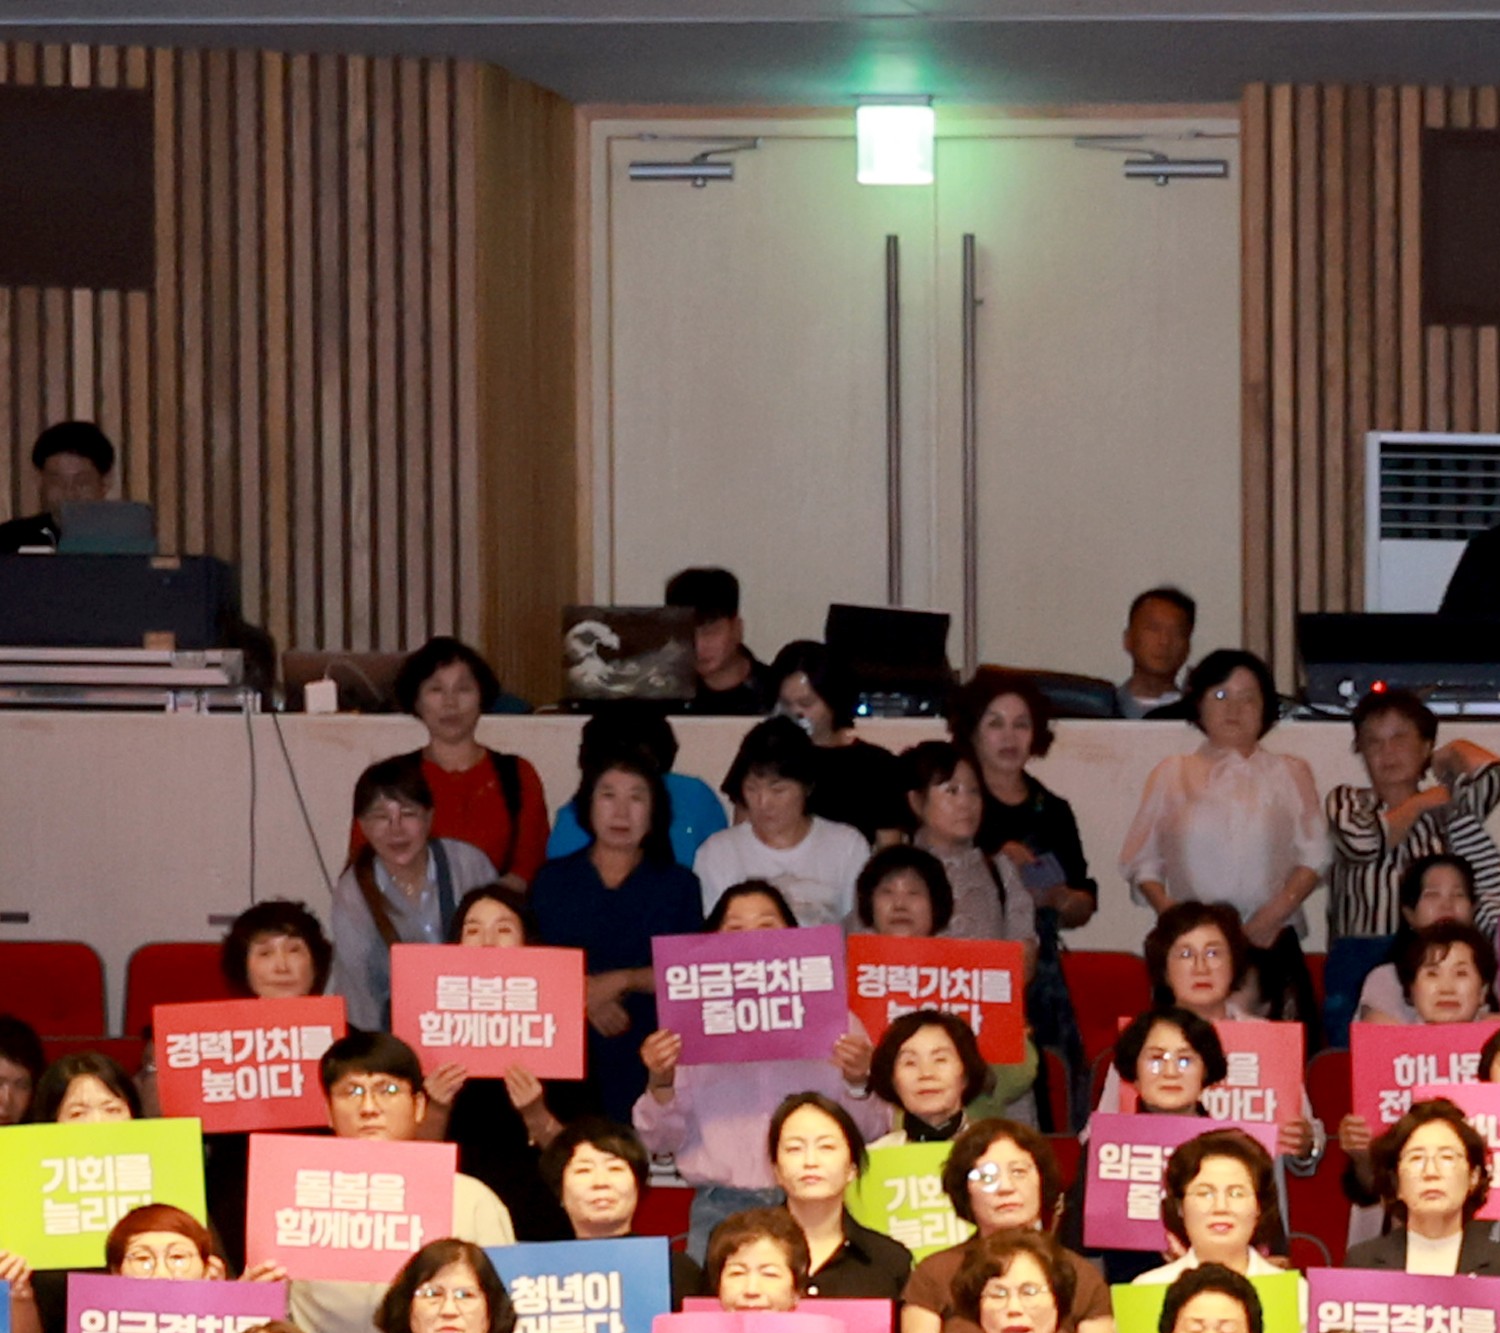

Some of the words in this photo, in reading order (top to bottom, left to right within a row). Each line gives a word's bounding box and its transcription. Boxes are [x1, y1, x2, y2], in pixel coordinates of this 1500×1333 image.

[437, 976, 537, 1011] 돌봄을
[666, 956, 833, 1000] 임금격차를
[859, 966, 1010, 1006] 경력가치를
[420, 1012, 555, 1046] 함께하다
[703, 996, 804, 1034] 줄이다
[168, 1026, 333, 1069] 경력가치를
[203, 1066, 303, 1102] 높이다
[42, 1155, 152, 1192] 기회를
[296, 1170, 404, 1211] 돌봄을
[276, 1209, 423, 1251] 함께하다
[511, 1272, 621, 1310] 청년이
